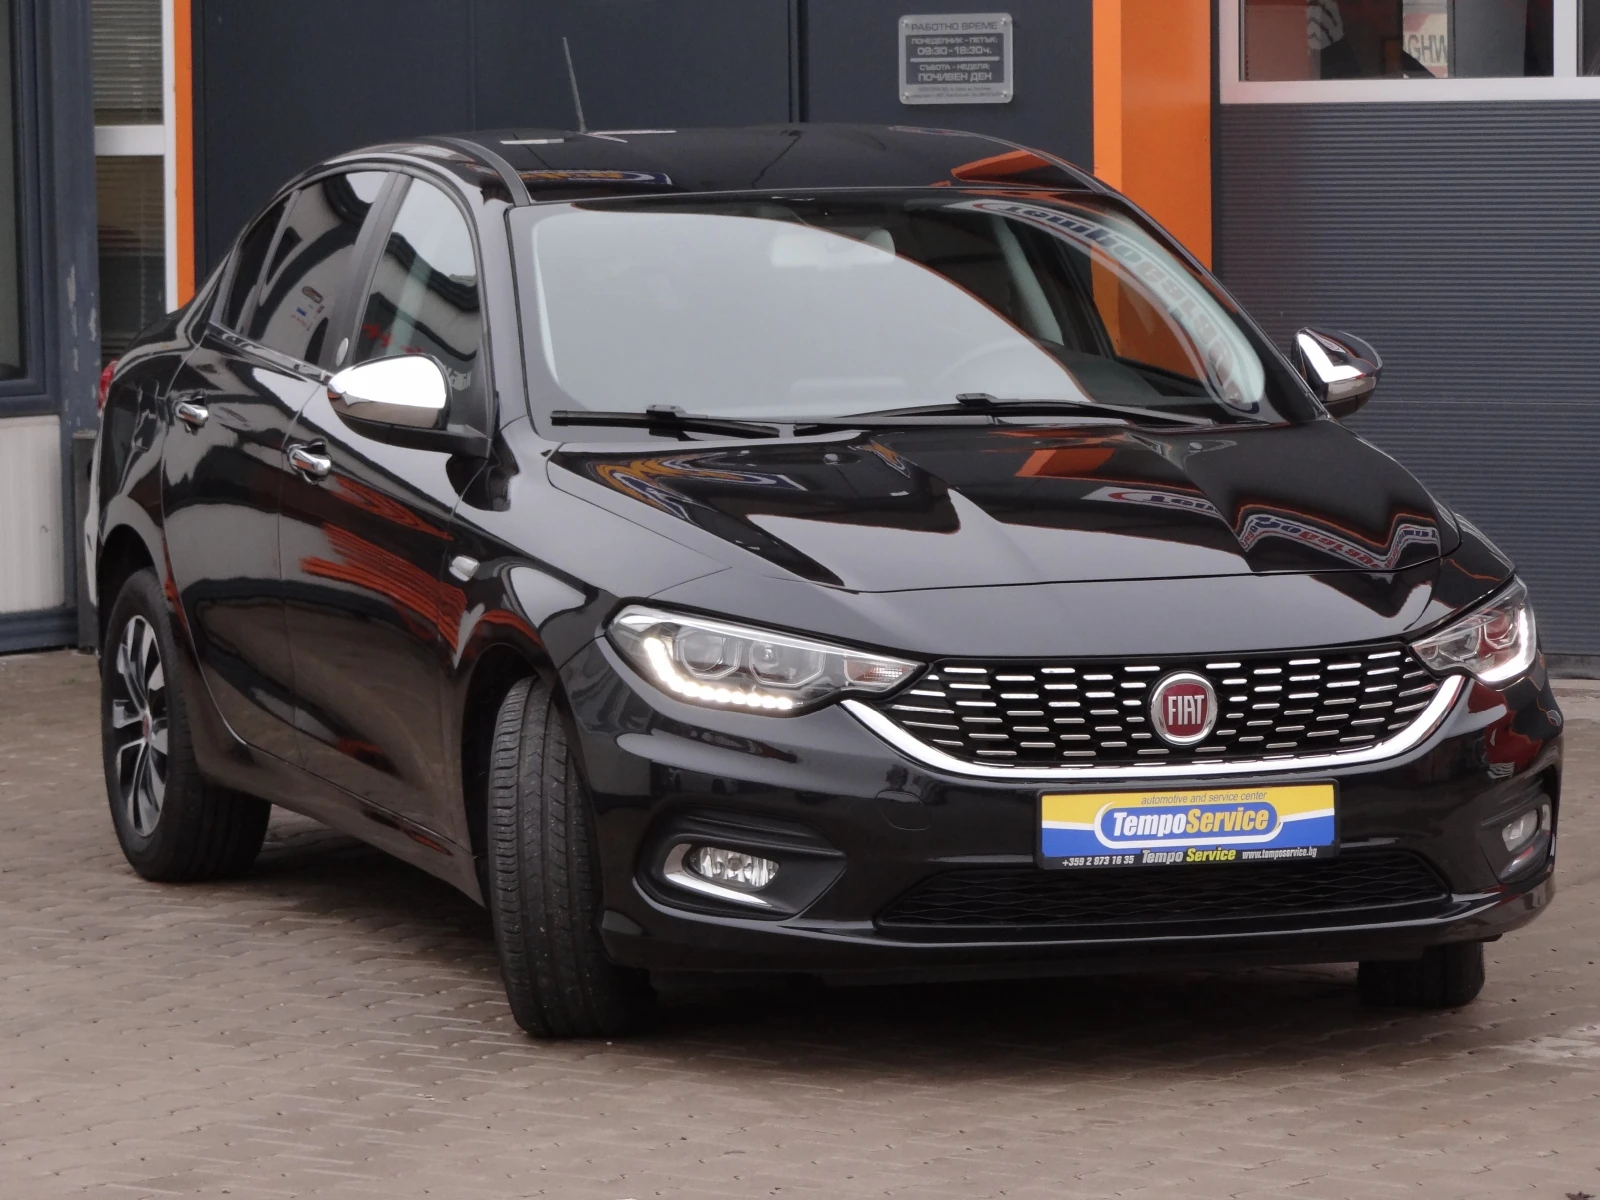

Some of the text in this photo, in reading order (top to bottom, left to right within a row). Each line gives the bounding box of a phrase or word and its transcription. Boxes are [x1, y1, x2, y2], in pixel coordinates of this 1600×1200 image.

[911, 22, 998, 31] РАБОТНО ВРЕМЕ
[917, 46, 948, 55] 09:30
[918, 72, 992, 82] ПОЧИВЕН ДЕН
[1168, 695, 1205, 725] FIAT
[1141, 791, 1267, 805] automotive and service center
[1113, 807, 1270, 837] TempoService
[1062, 847, 1318, 867] +359 2 973 16 35 Tempo Service www.temposervice.bg
